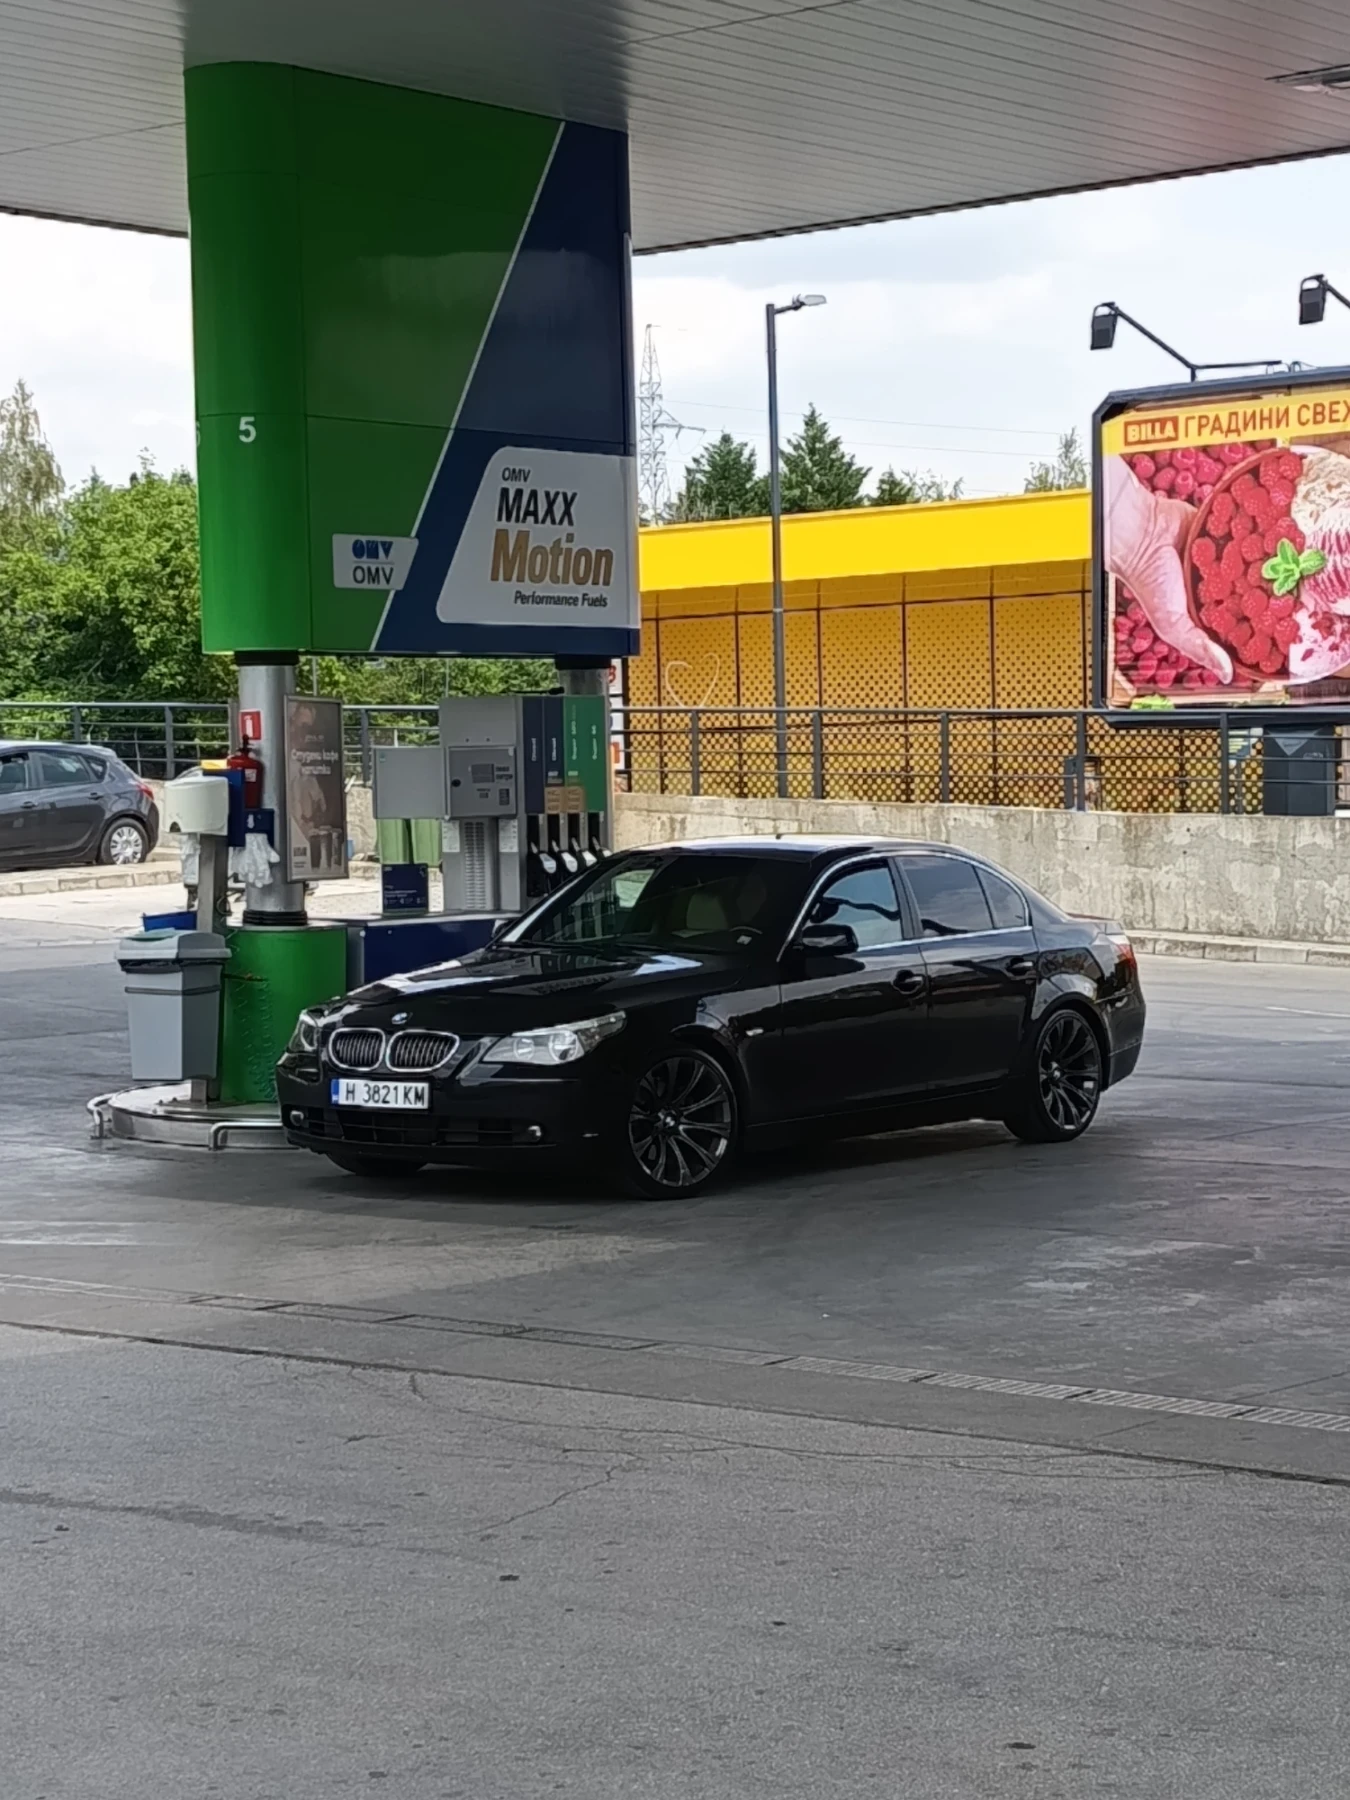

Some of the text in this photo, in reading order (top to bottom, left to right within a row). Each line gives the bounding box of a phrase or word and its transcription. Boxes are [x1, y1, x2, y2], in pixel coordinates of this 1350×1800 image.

[239, 416, 257, 443] 5
[1126, 419, 1176, 443] BILLA
[1185, 405, 1289, 438] ГРАДИНИ
[501, 467, 531, 482] OMV
[496, 486, 578, 526] MAXX
[490, 528, 614, 587] Motion
[352, 565, 394, 586] OMV
[514, 590, 609, 608] Performance Fuels
[363, 1083, 399, 1105] 3821
